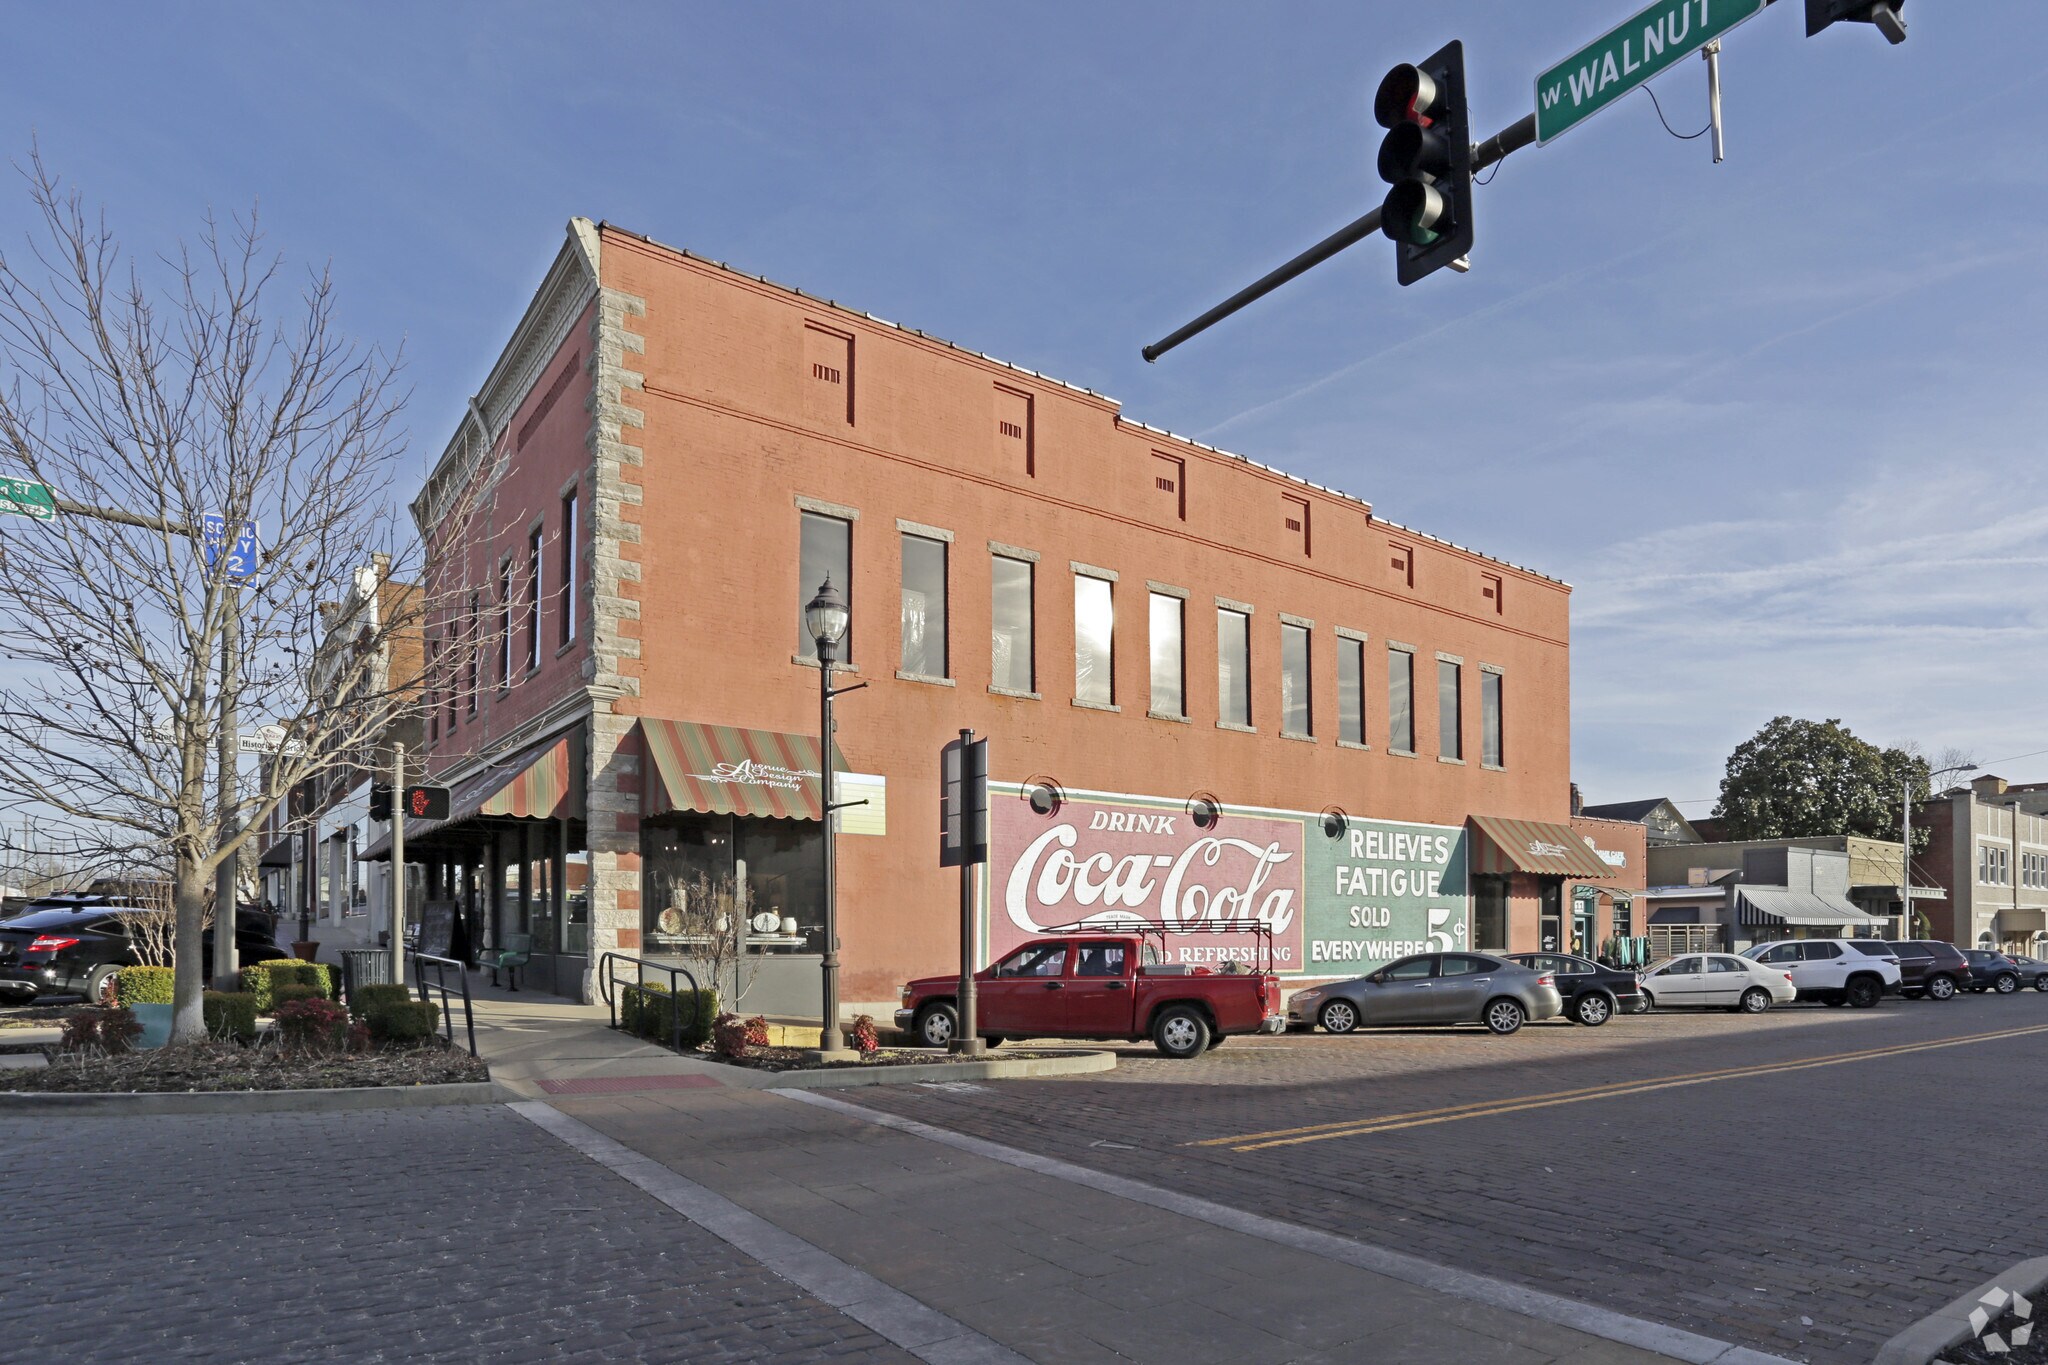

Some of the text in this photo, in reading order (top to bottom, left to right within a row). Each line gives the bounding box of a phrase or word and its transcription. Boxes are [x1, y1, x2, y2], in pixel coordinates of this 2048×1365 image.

[1568, 0, 1708, 107] WALNUT
[14, 482, 32, 496] ST
[206, 521, 254, 538] SCIC
[209, 537, 251, 553] HY
[712, 759, 789, 779] Avenue
[752, 766, 804, 784] Design
[734, 774, 802, 792] Company
[1089, 810, 1177, 835] DRINK
[1350, 829, 1449, 865] RELIEVES
[1005, 823, 1294, 935] Coca-Cola
[1336, 865, 1441, 898] FATIGUE
[1350, 905, 1391, 928] SOLD
[1425, 908, 1466, 954] 5¢
[1179, 946, 1291, 962] REFRESHING
[1311, 939, 1424, 962] EVERYWHERE
